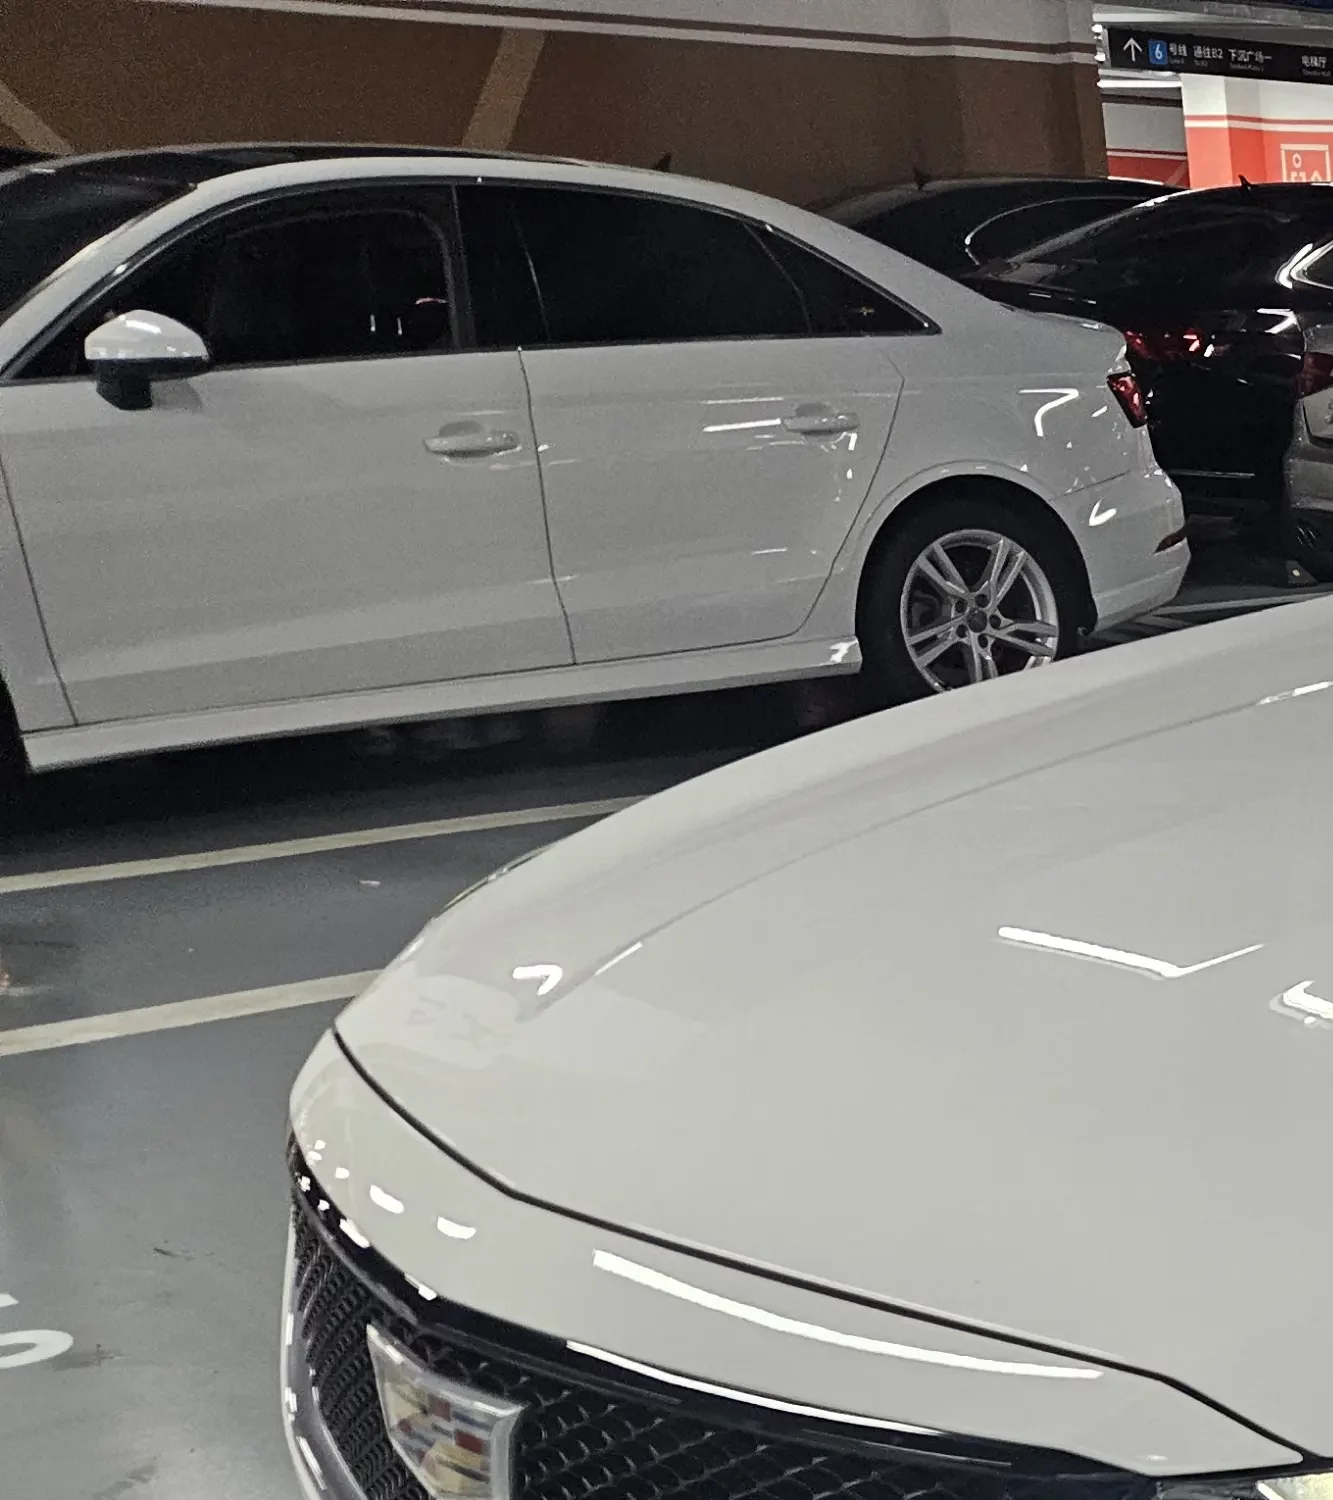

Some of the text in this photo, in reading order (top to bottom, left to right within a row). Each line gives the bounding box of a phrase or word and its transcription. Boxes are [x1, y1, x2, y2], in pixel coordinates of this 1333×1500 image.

[1154, 44, 1163, 60] 6
[1169, 43, 1188, 57] 号线
[1193, 45, 1224, 60] 通往B2
[1301, 55, 1327, 69] 电梯厅
